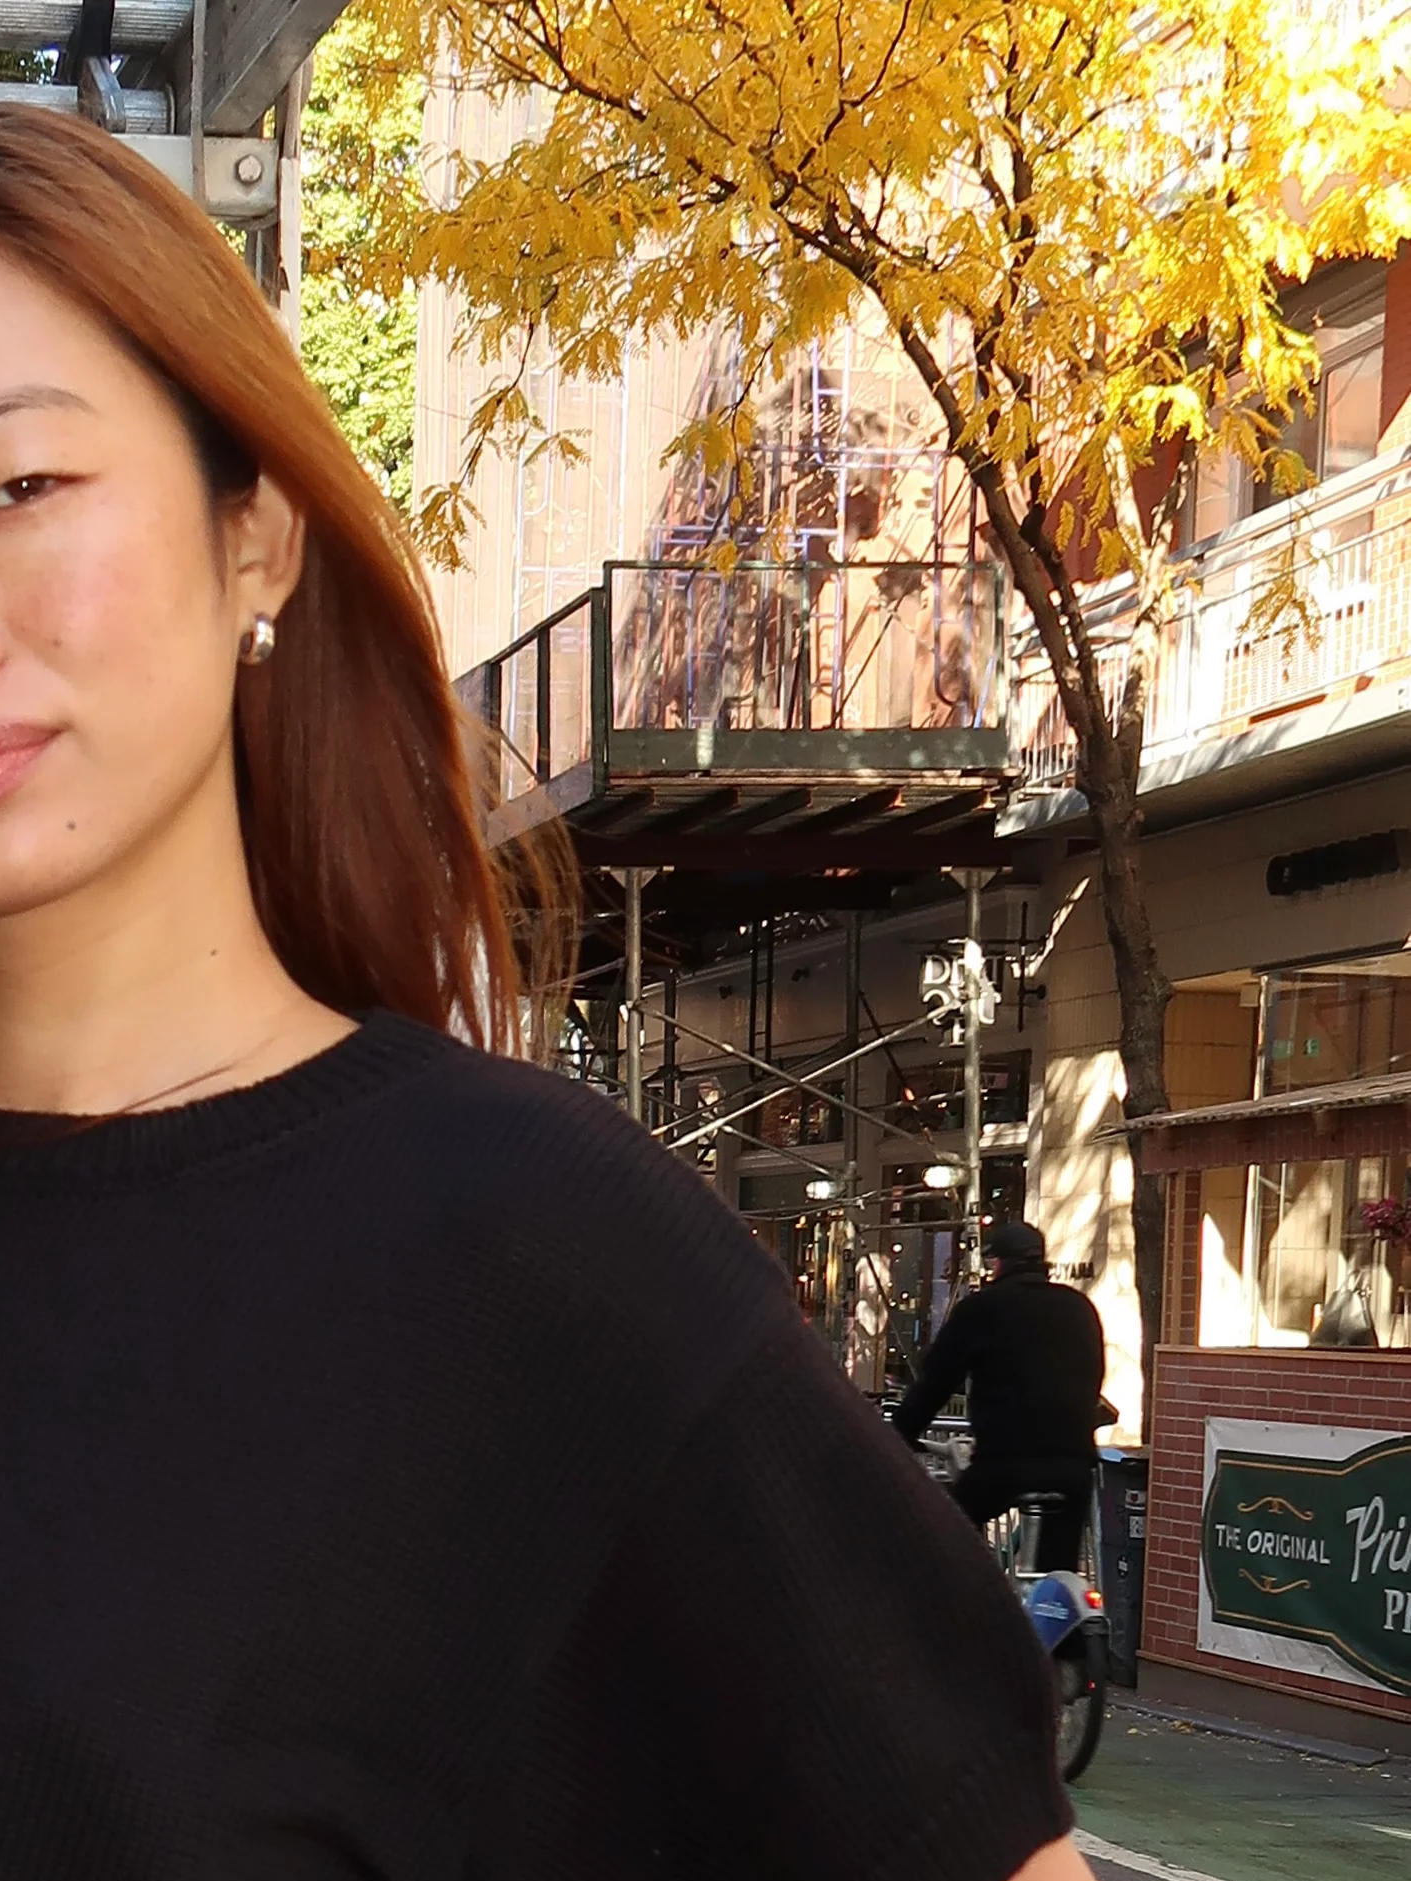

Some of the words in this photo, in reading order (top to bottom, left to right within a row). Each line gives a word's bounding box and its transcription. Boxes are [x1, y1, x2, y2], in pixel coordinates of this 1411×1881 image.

[1214, 1523, 1242, 1551] THE
[1247, 1531, 1330, 1564] ORIGINAL
[1345, 1495, 1411, 1583] Pri
